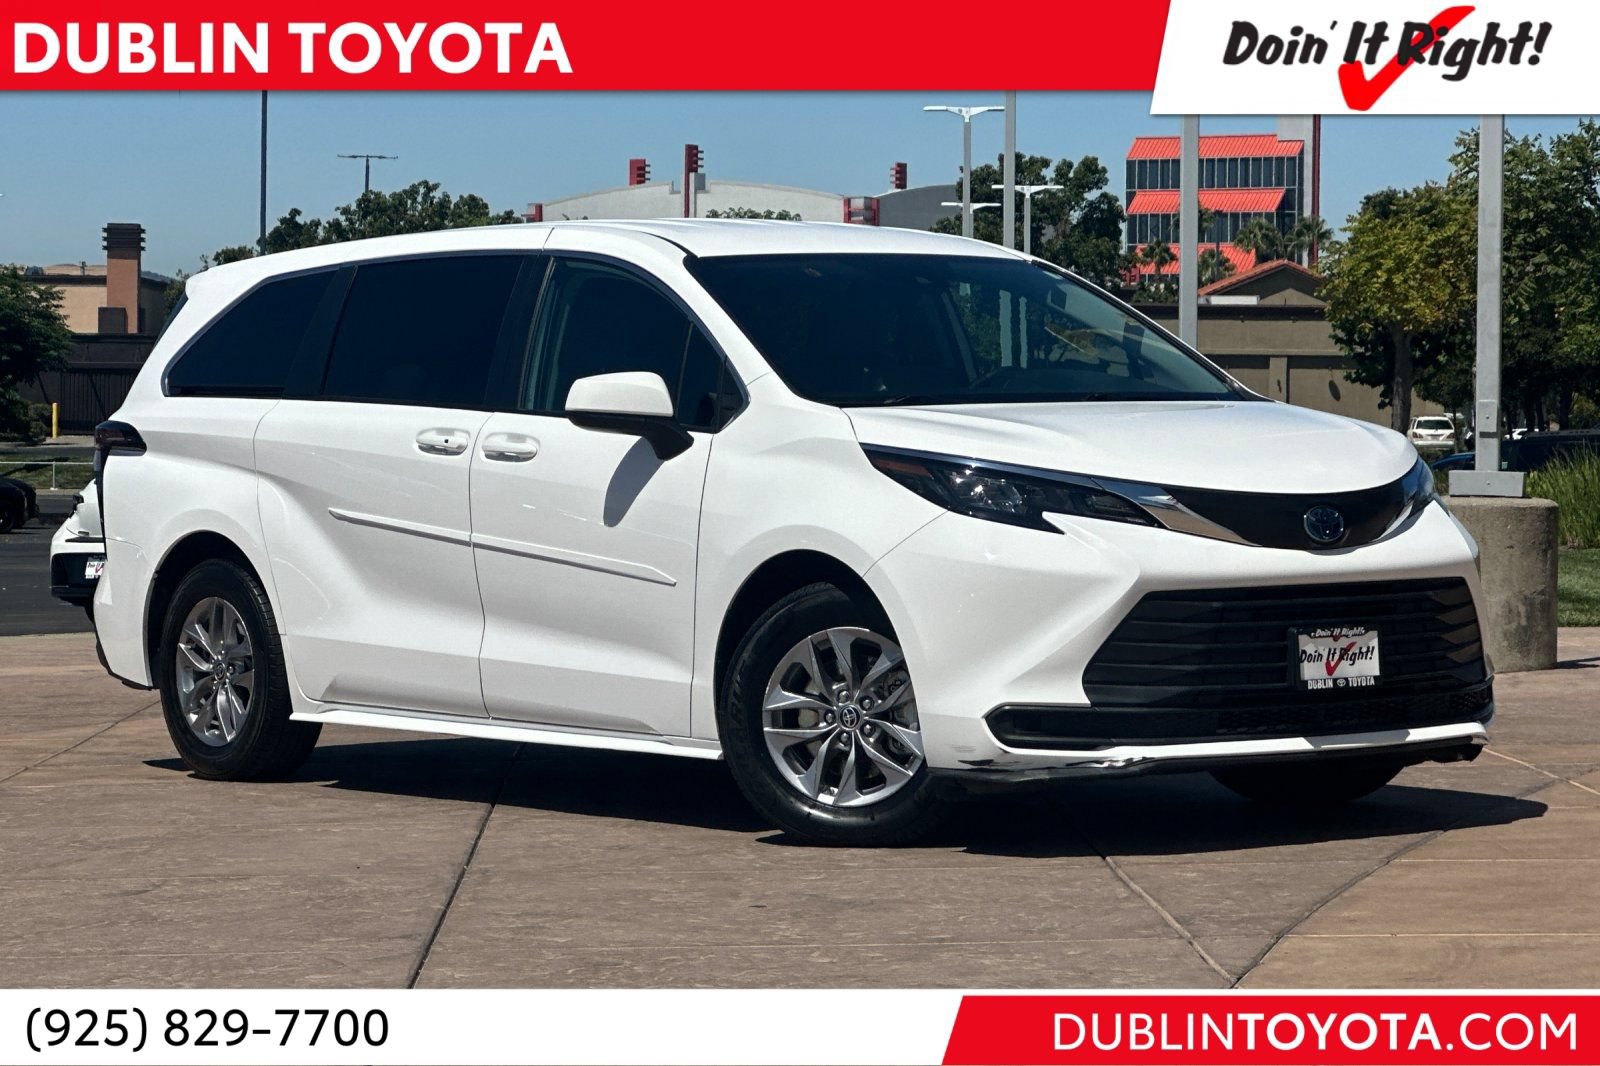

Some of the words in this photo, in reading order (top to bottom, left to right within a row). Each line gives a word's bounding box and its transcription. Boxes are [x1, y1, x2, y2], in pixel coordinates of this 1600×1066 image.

[1326, 647, 1337, 662] It
[1339, 645, 1375, 666] Right!
[1307, 678, 1334, 690] DUBLIN
[1347, 676, 1375, 688] TOYOTA
